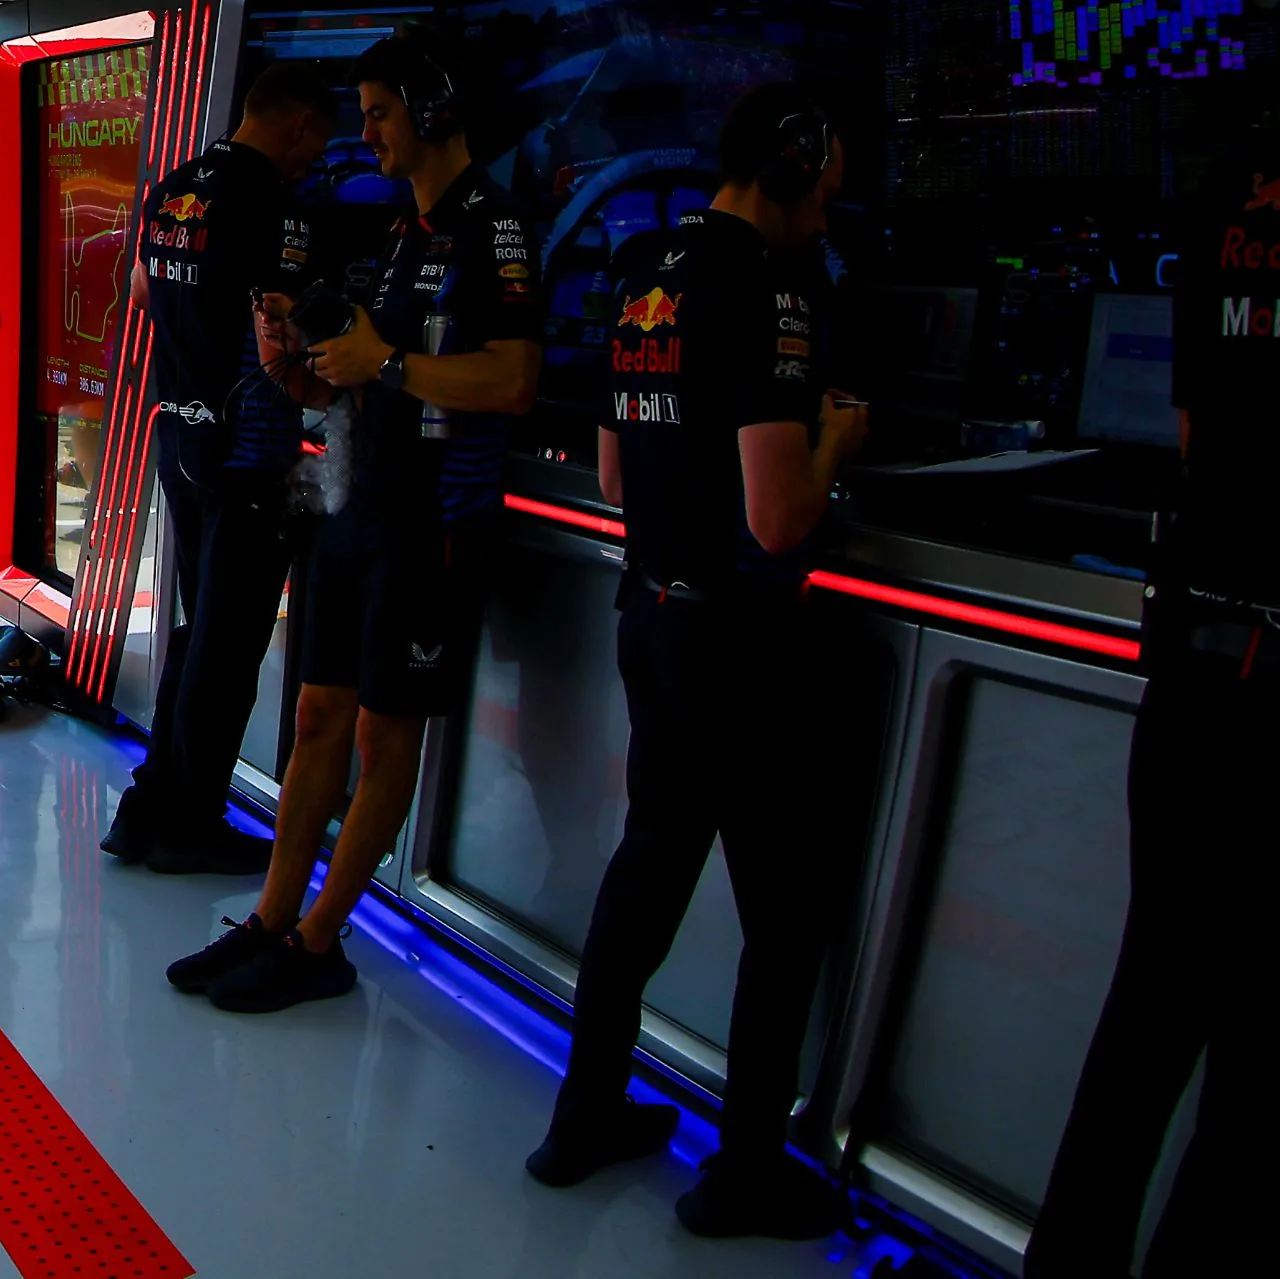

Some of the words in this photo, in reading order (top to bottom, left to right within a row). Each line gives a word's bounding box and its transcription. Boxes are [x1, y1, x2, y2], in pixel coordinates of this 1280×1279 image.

[48, 117, 140, 149] HUNGARY
[493, 220, 521, 232] VISA
[496, 247, 529, 260] ROKT
[149, 256, 182, 282] Mobil
[79, 363, 108, 378] DISTANCE
[614, 392, 661, 422] Mobil
